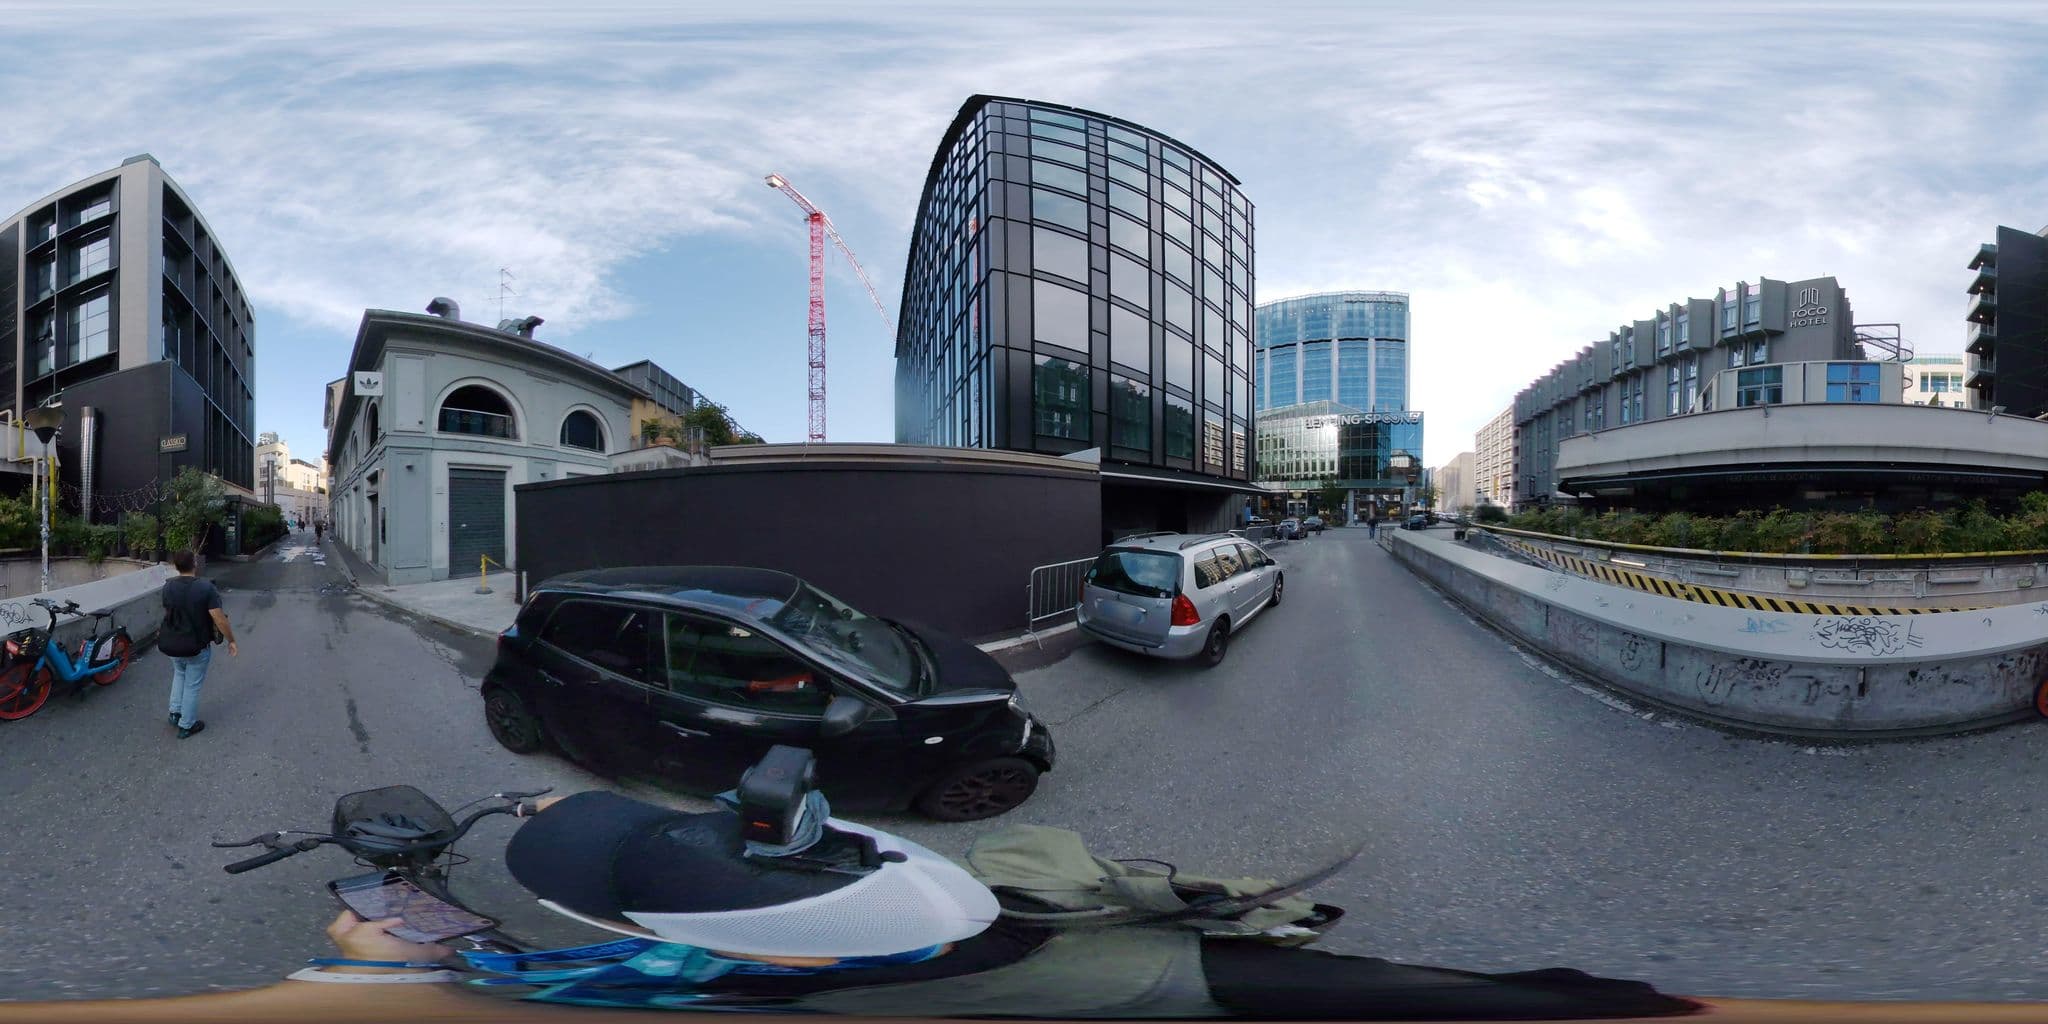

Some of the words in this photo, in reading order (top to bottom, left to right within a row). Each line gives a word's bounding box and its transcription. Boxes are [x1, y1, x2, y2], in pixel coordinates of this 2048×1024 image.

[1792, 306, 1827, 318] TOCQ
[1790, 317, 1827, 328] HOTEL
[1304, 414, 1360, 429] BENDING
[1364, 412, 1420, 425] SPOONS
